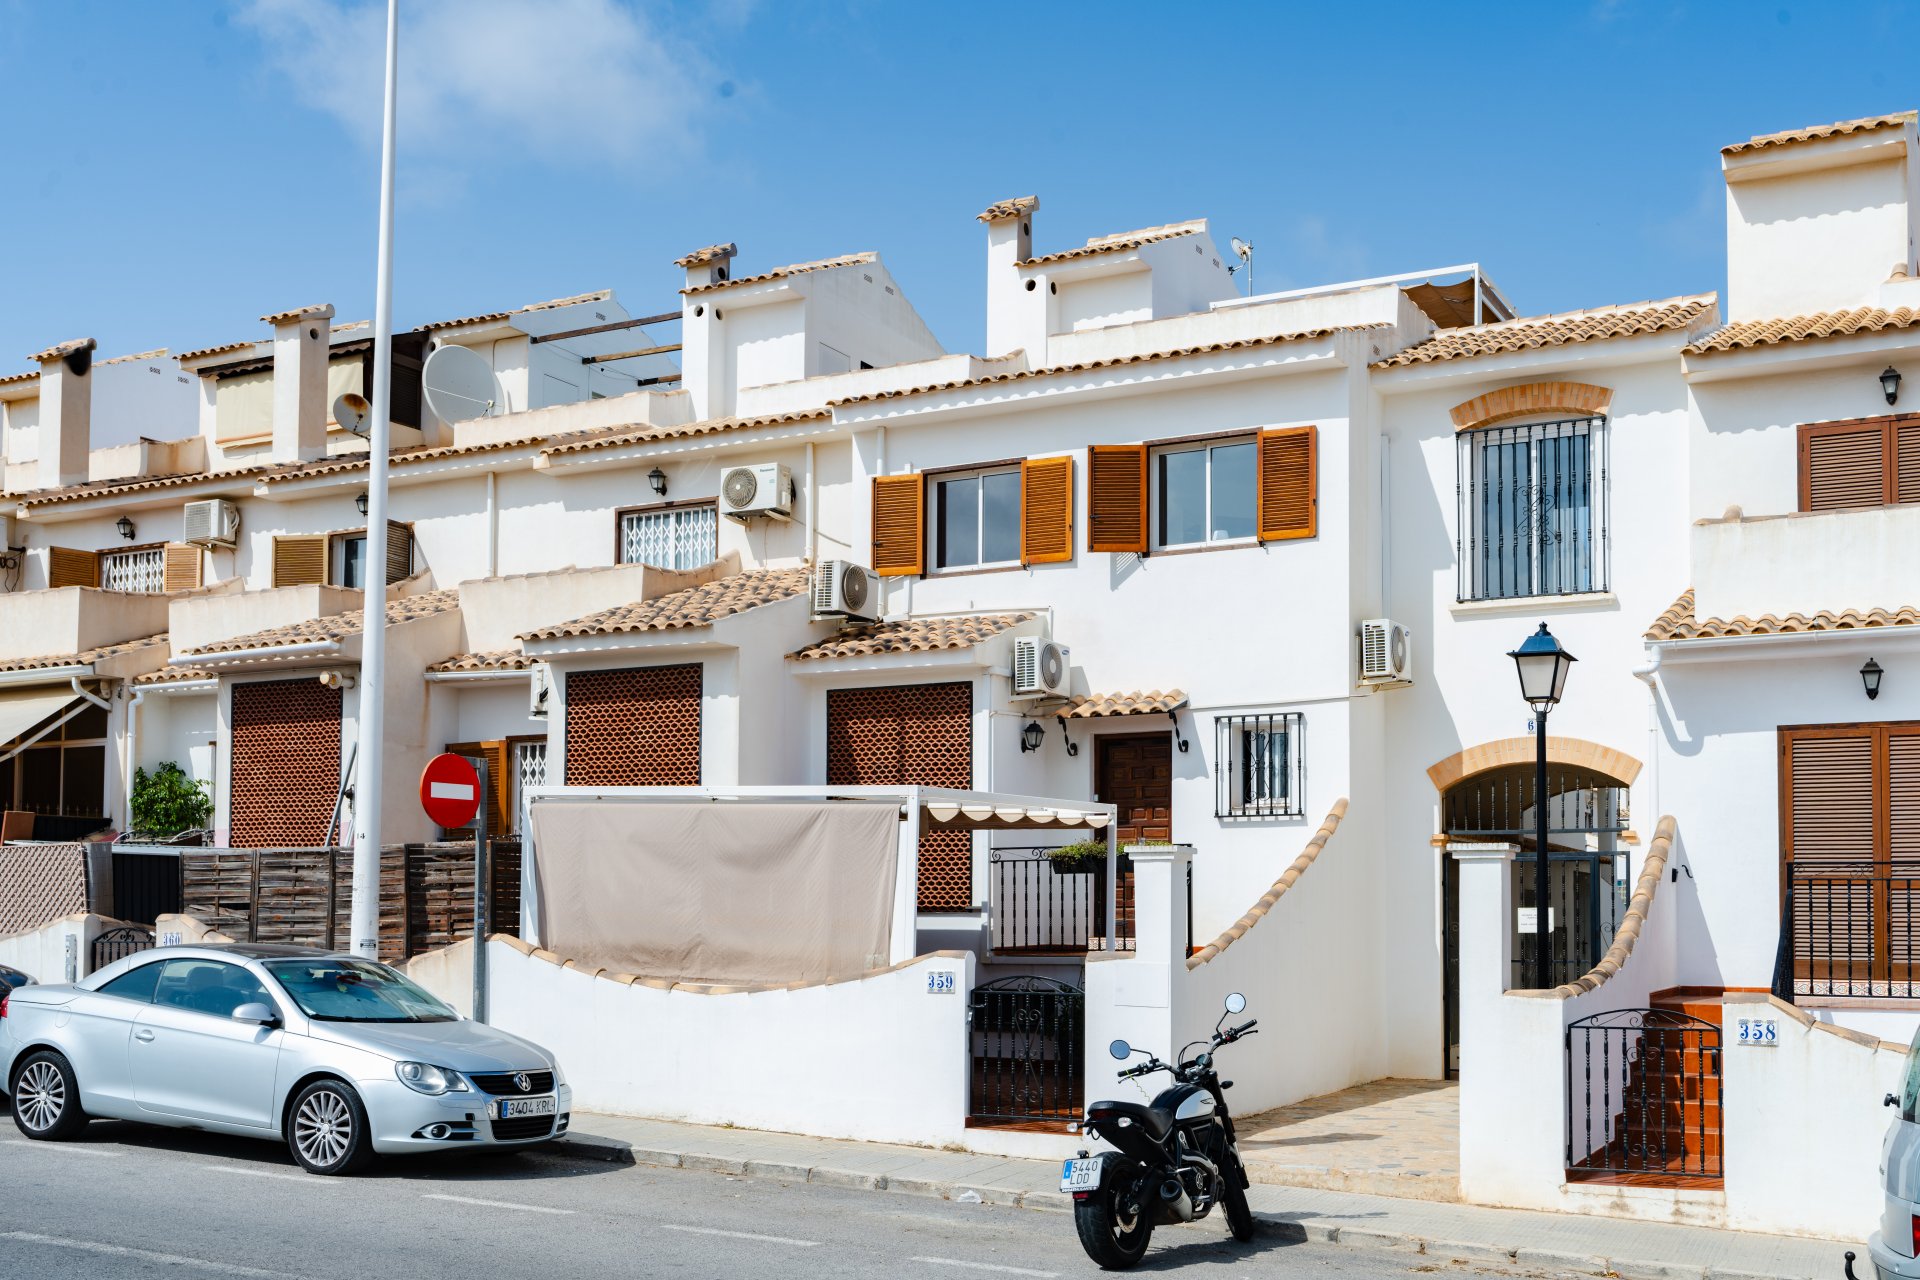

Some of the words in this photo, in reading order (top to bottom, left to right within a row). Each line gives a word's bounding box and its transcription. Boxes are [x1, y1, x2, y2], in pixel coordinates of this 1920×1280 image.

[1528, 720, 1534, 731] 6
[163, 935, 180, 946] 360
[928, 975, 953, 989] 359
[1740, 1024, 1775, 1041] 358
[509, 1101, 534, 1115] 3404
[1072, 1160, 1098, 1173] 5440
[1070, 1173, 1090, 1185] LDD
